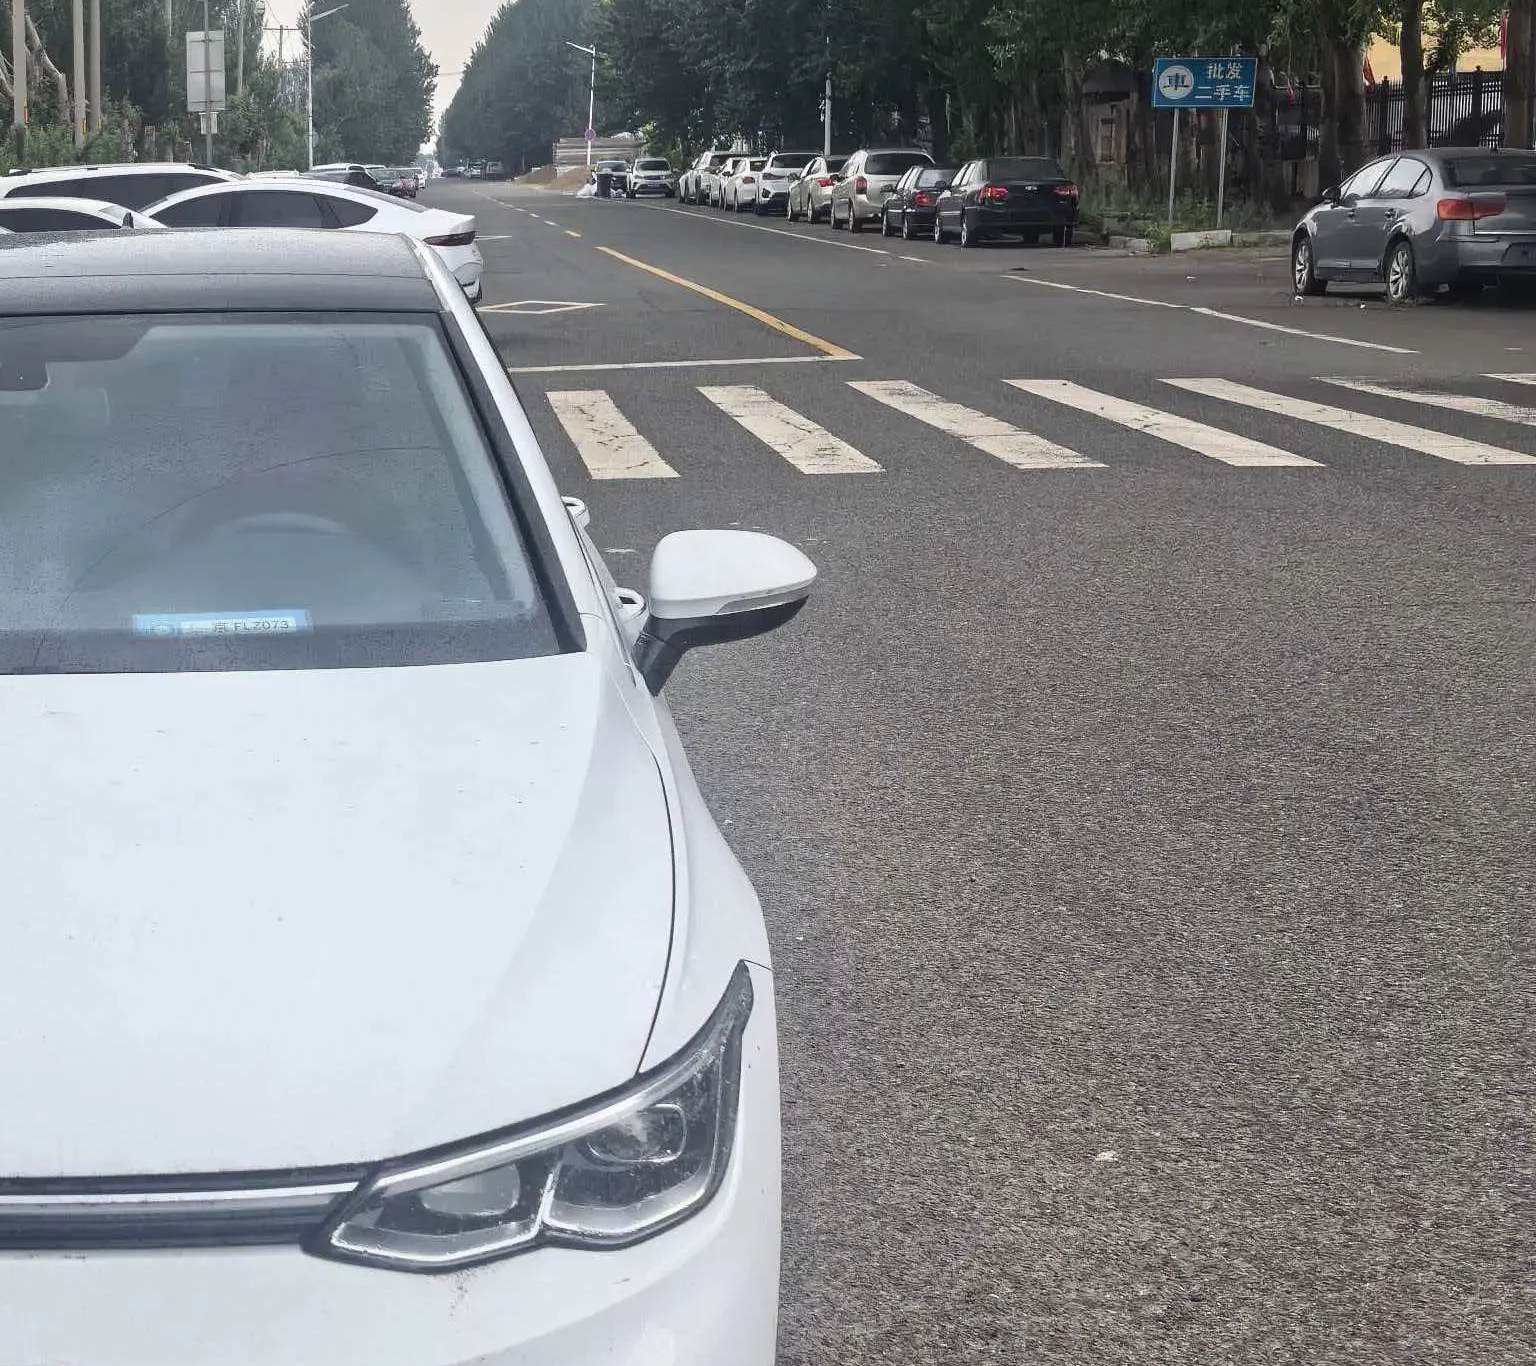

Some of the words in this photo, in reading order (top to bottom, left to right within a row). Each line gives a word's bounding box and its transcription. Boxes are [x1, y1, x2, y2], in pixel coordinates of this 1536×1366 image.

[1206, 61, 1243, 80] 批发
[1194, 84, 1250, 102] 二手车
